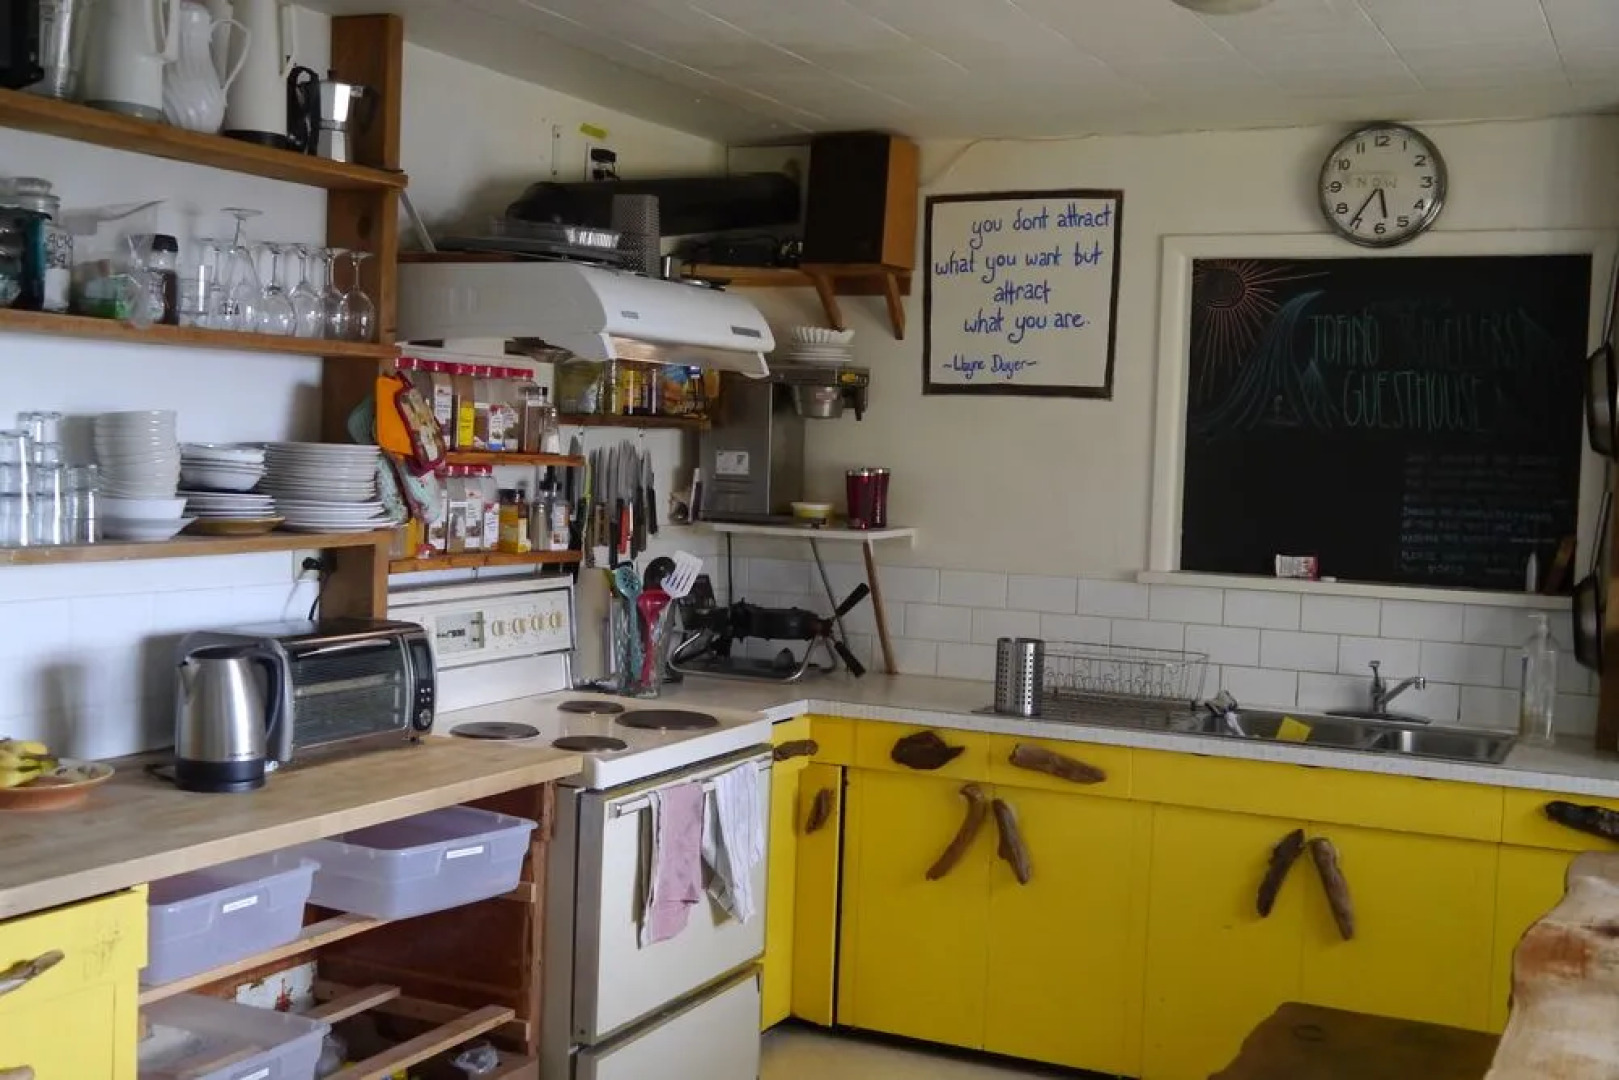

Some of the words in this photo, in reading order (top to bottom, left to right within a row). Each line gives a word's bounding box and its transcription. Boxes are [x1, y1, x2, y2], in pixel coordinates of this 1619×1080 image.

[1374, 135, 1391, 147] 12
[1356, 142, 1366, 155] 11
[1338, 158, 1351, 171] 10
[1414, 154, 1427, 168] 2
[1329, 180, 1343, 194] 9
[1420, 176, 1434, 189] 3
[1335, 202, 1349, 215] 8
[1413, 199, 1425, 210] 4
[969, 219, 1003, 250] you
[1013, 207, 1050, 231] dont
[1057, 202, 1112, 228] attract
[1396, 216, 1410, 228] 5
[1373, 223, 1387, 235] 6
[935, 248, 974, 276] what
[982, 254, 1016, 284] you
[1025, 245, 1062, 267] want
[1074, 240, 1104, 266] but
[993, 280, 1051, 305] attract
[963, 307, 1005, 334] what
[1007, 314, 1047, 344] you
[1053, 313, 1091, 329] are.
[1306, 311, 1380, 367] TOFINO
[1342, 370, 1490, 433] GUESTHOUSE
